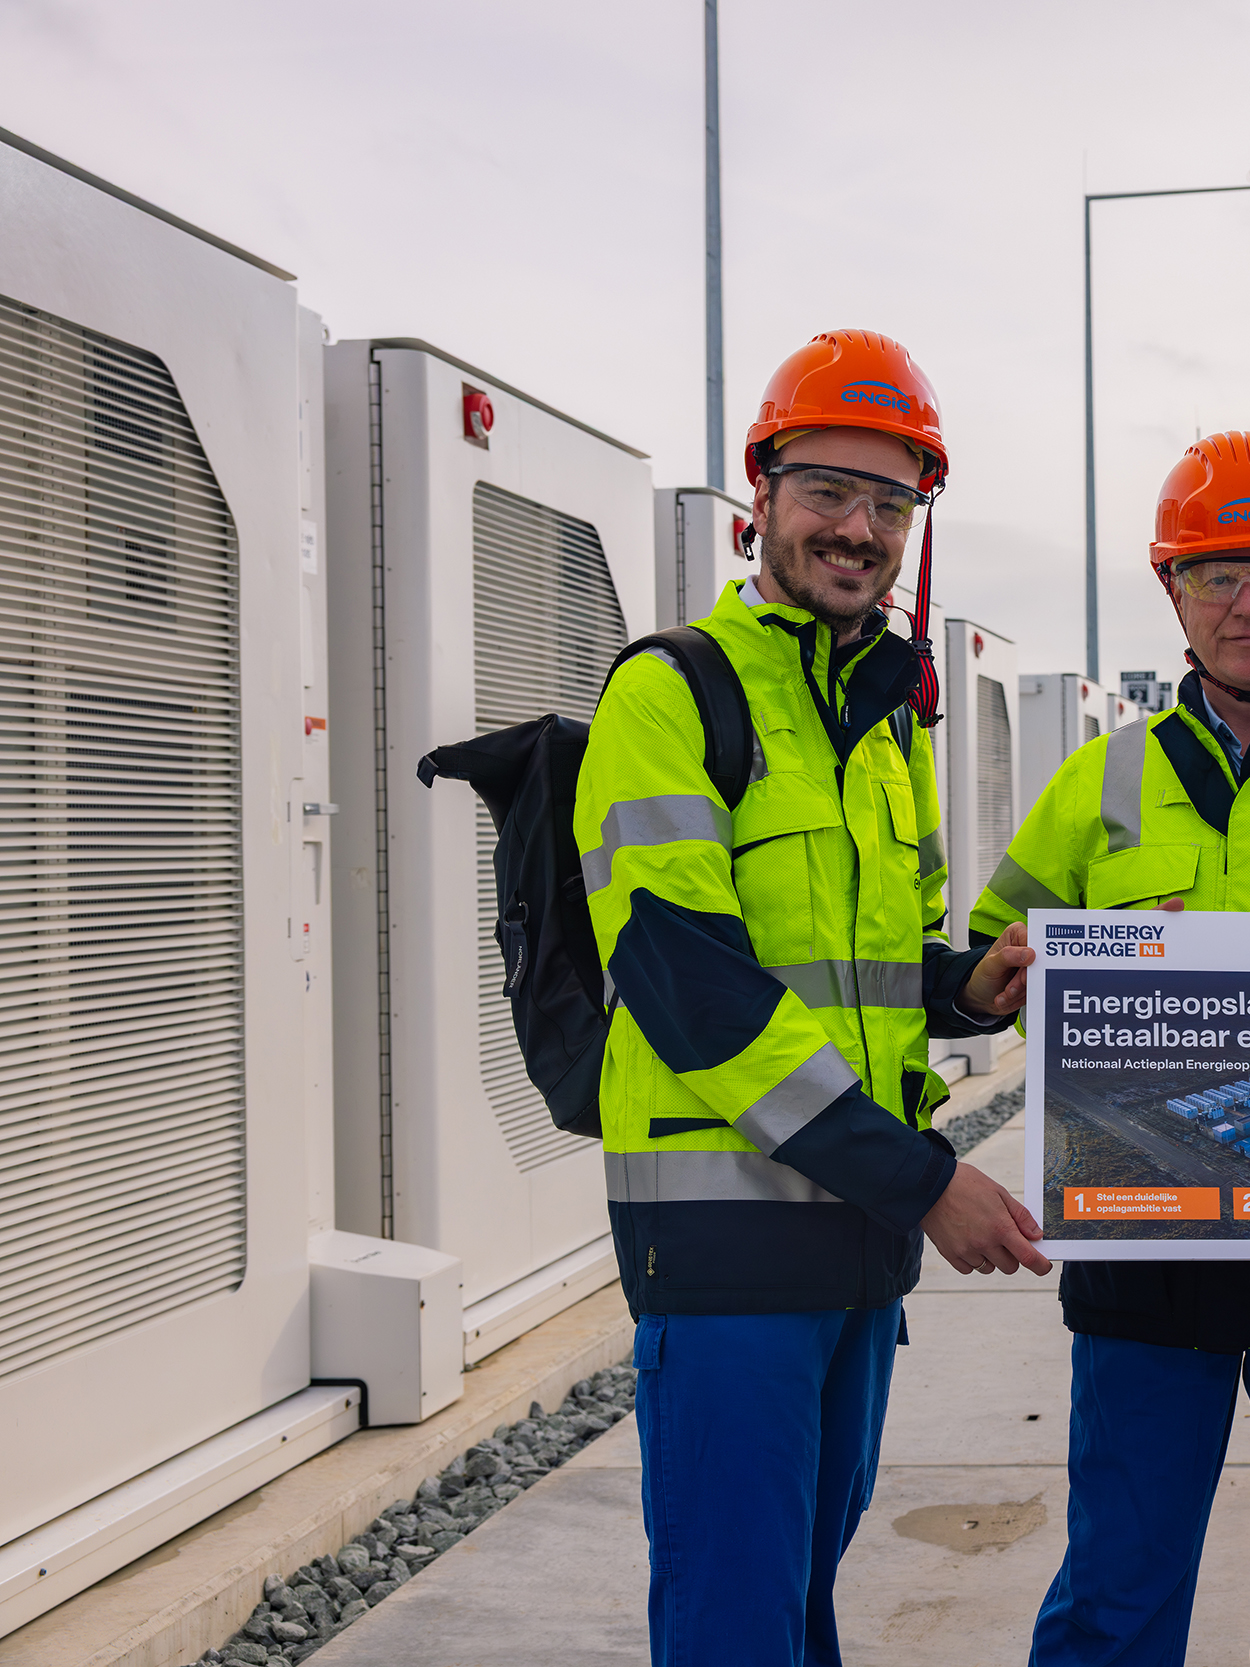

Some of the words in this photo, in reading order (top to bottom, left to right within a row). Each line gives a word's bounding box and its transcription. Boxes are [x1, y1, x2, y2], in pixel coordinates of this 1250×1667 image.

[1088, 925, 1165, 940] ENERGY
[1045, 942, 1136, 957] STORAGE
[1143, 945, 1162, 956] NL
[1063, 1022, 1230, 1048] betaalbaar
[1061, 1058, 1121, 1069] Nationaal
[1123, 1058, 1184, 1072] Actieplan
[1074, 1193, 1091, 1212] 1.
[1096, 1193, 1115, 1201] Stel
[1134, 1193, 1178, 1203] duidelijke
[1096, 1204, 1161, 1214] opslagambitie
